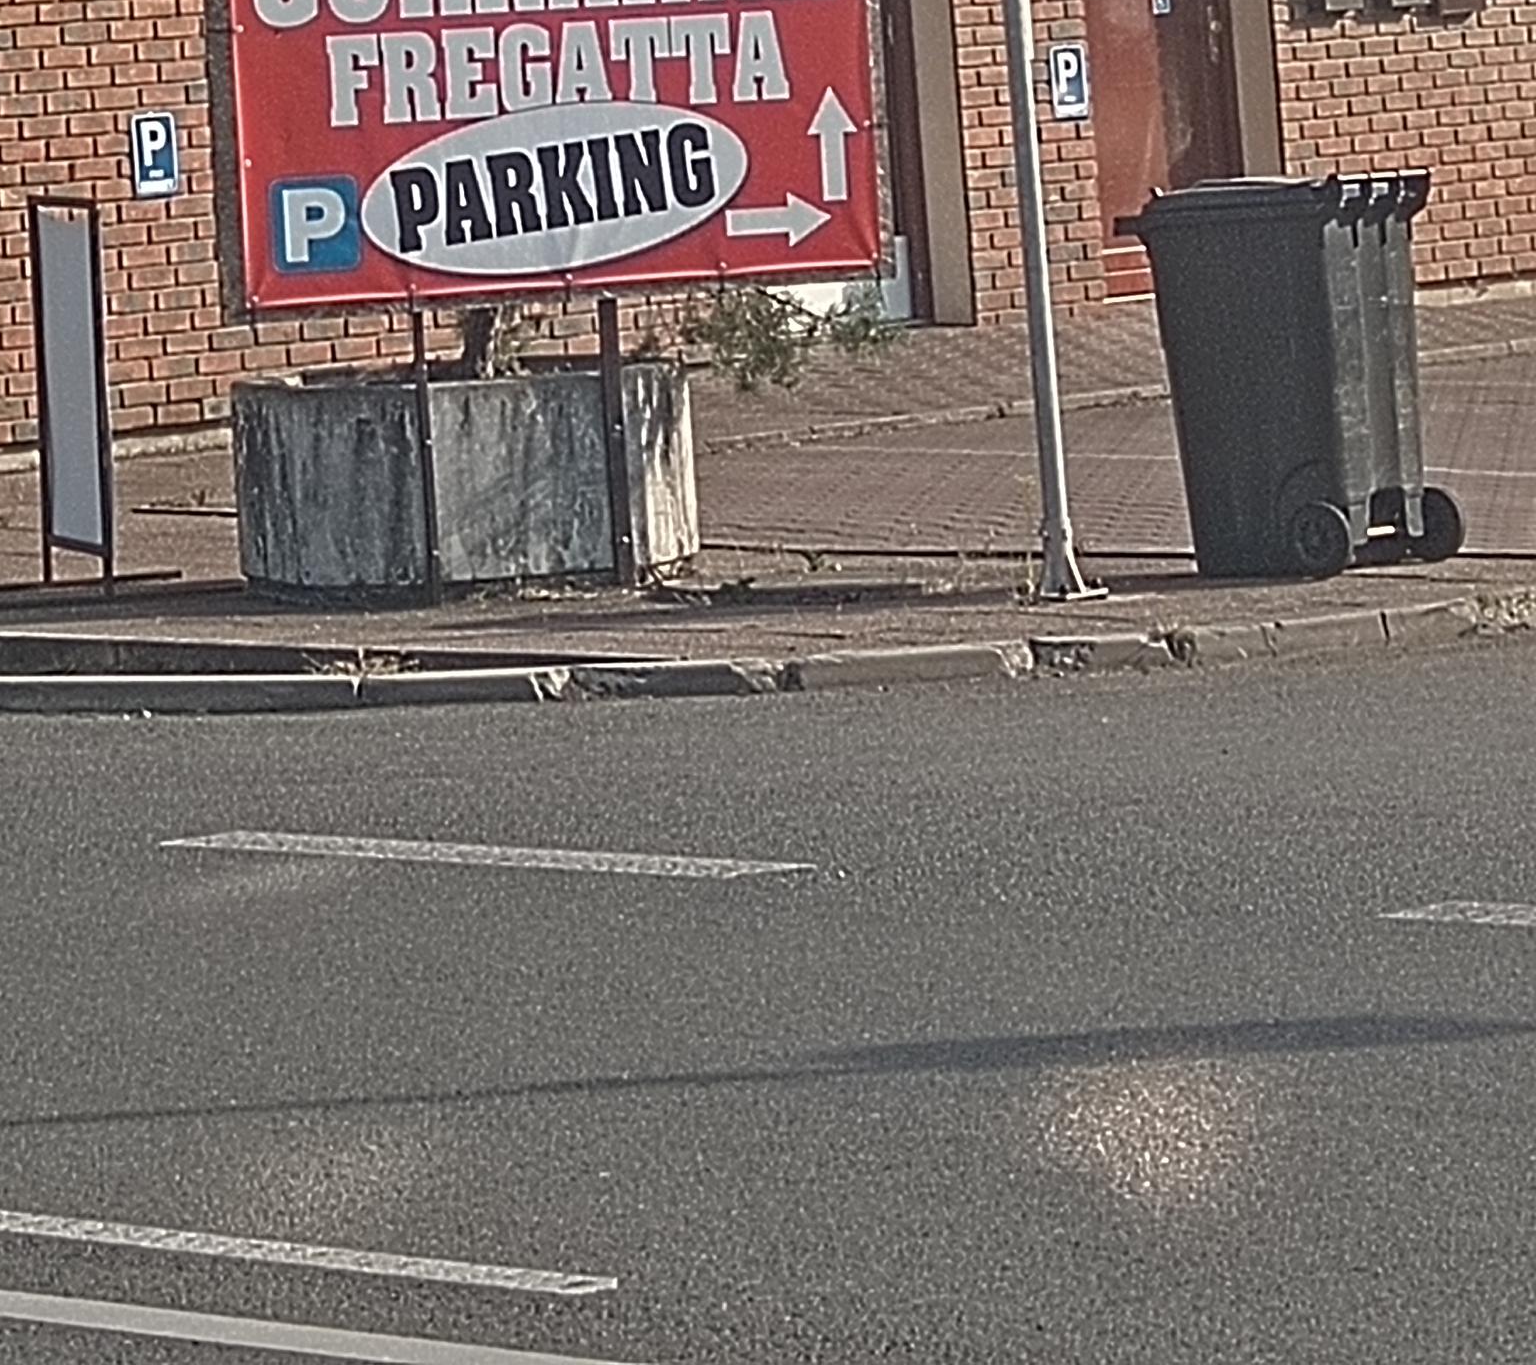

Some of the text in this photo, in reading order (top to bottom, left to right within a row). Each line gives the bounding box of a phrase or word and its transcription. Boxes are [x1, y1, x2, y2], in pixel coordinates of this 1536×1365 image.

[325, 9, 790, 128] FREGATTA
[1056, 51, 1078, 93] P
[140, 121, 166, 167] P
[282, 187, 347, 264] P
[389, 121, 717, 254] PARKING
